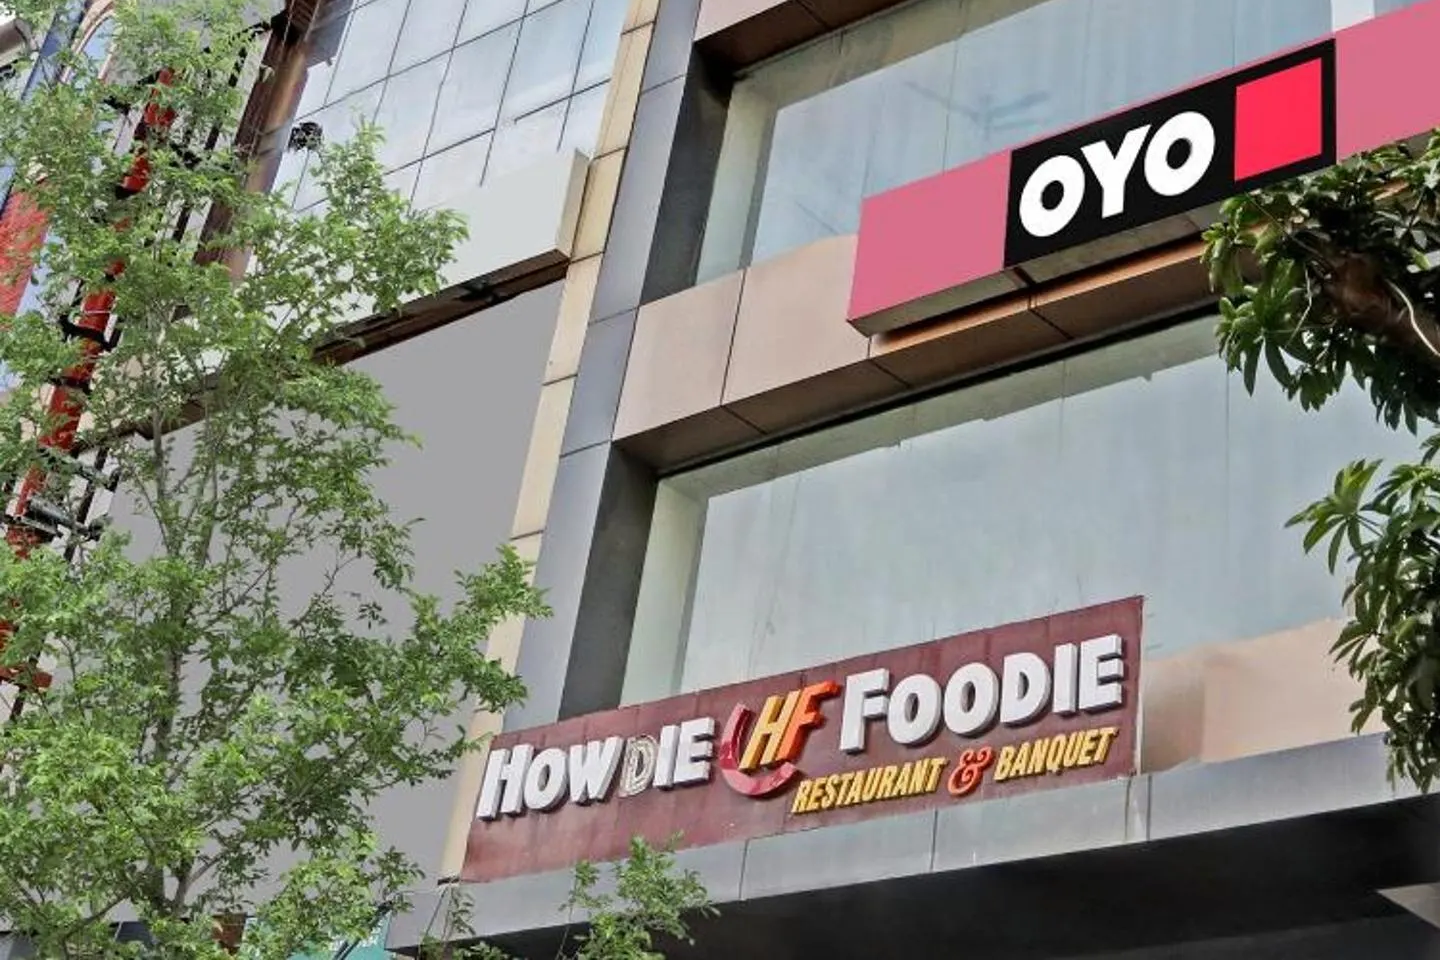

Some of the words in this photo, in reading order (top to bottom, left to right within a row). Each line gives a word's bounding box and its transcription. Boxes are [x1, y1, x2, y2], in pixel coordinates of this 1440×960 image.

[1019, 110, 1216, 238] OYO
[476, 716, 716, 821] HOWDIE
[839, 633, 1125, 754] FOODIE
[791, 755, 950, 815] RESTAURANT
[946, 746, 991, 798] &
[992, 725, 1118, 783] BANQUET
